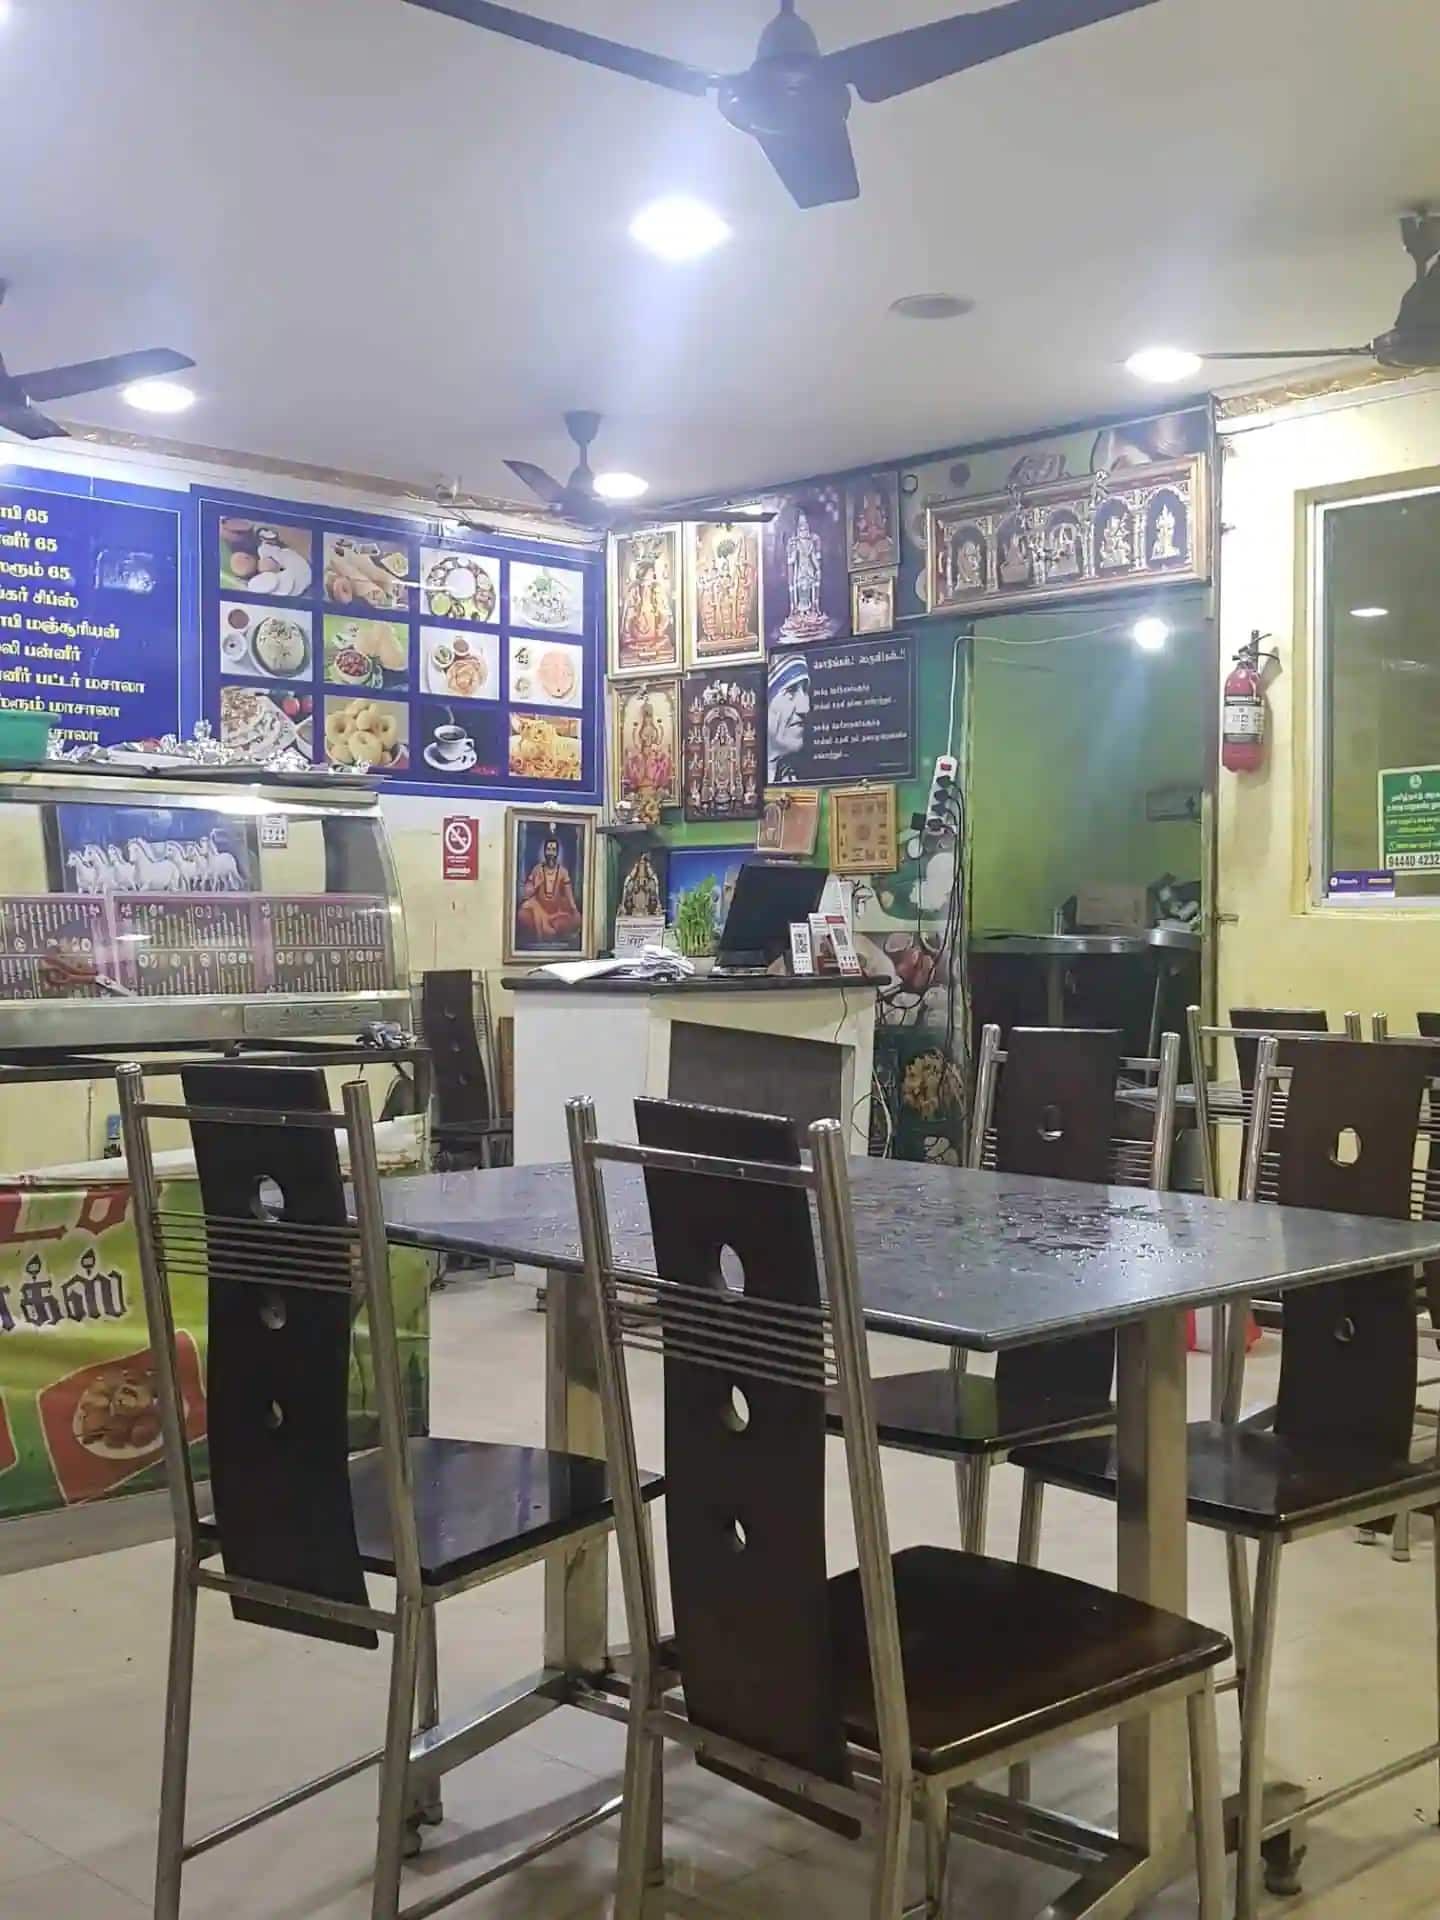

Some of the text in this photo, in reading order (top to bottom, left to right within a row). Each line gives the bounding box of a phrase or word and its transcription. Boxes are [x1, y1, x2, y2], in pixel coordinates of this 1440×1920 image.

[27, 509, 49, 524] 65
[35, 537, 58, 552] 65
[48, 565, 71, 580] 65
[33, 588, 79, 608] சிப்ஸ்
[24, 643, 82, 661] பன்னீர்
[36, 671, 82, 688] பட்டர்
[85, 678, 145, 693] மசாலா
[1388, 855, 1416, 867] 94440
